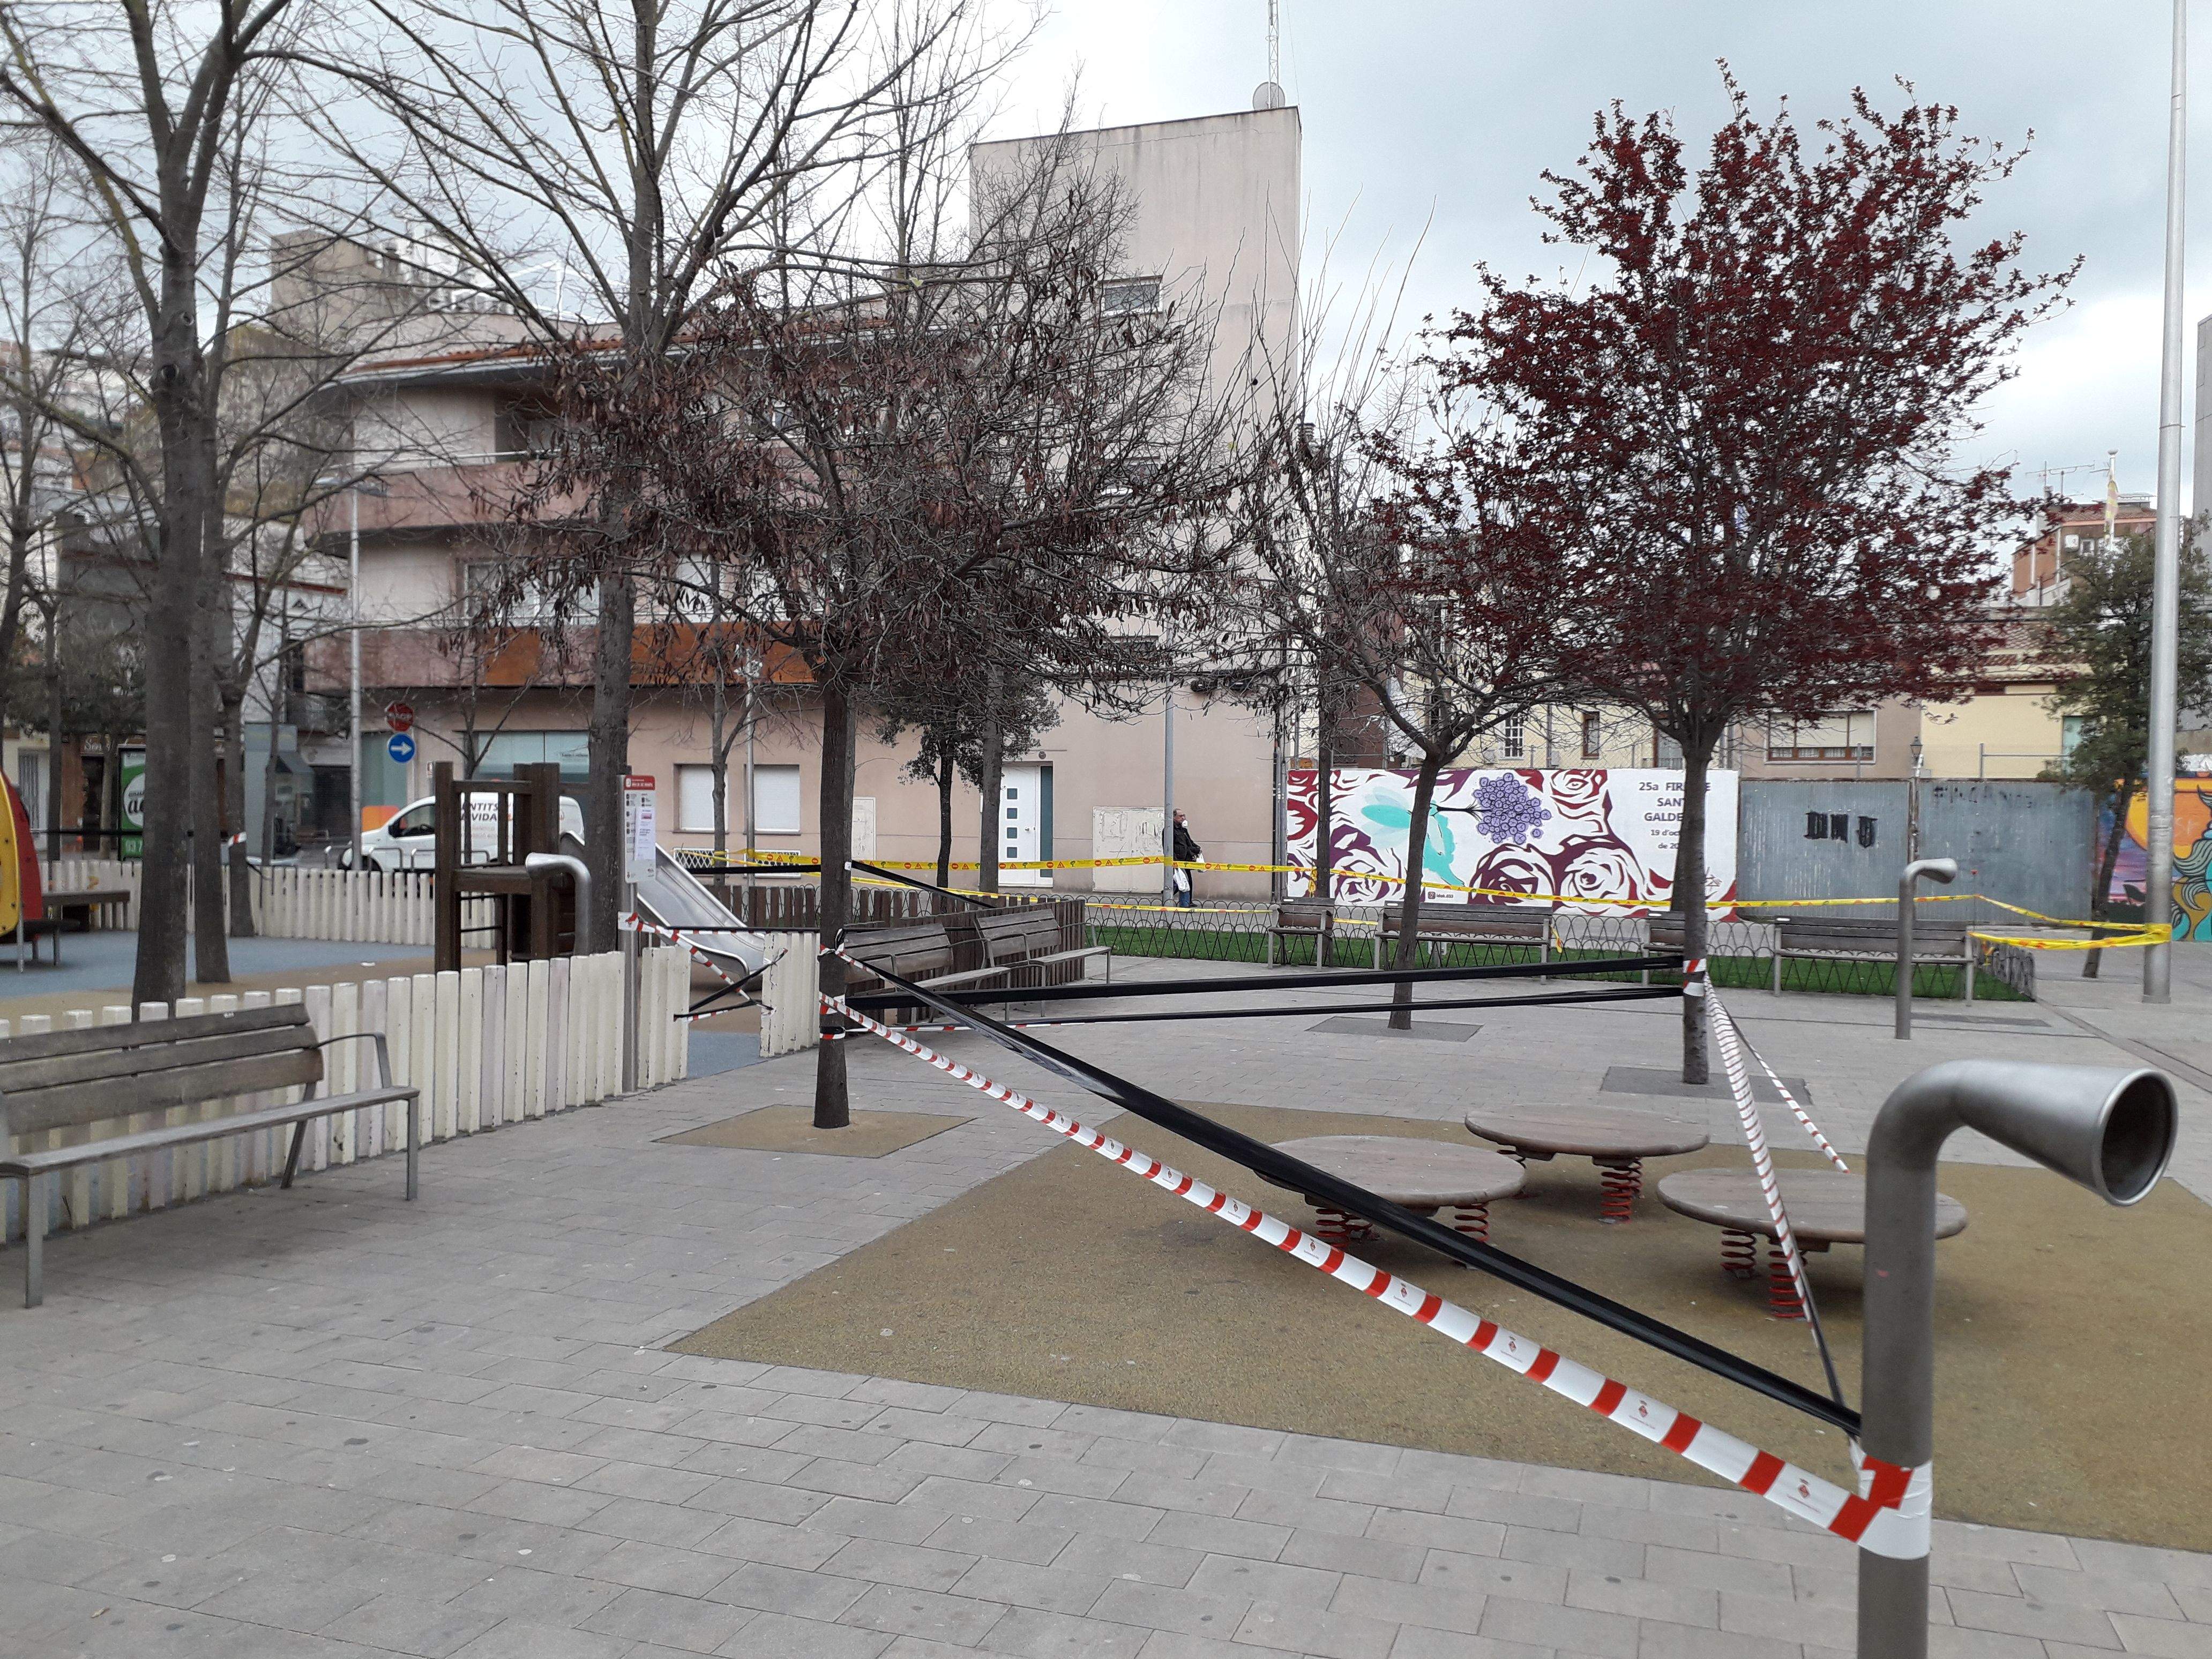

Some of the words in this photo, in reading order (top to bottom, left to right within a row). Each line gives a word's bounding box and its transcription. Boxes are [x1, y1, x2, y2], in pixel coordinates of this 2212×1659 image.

[1639, 782, 1659, 791] 25a
[1666, 782, 1685, 791] FIR
[1644, 812, 1684, 821] GALDE
